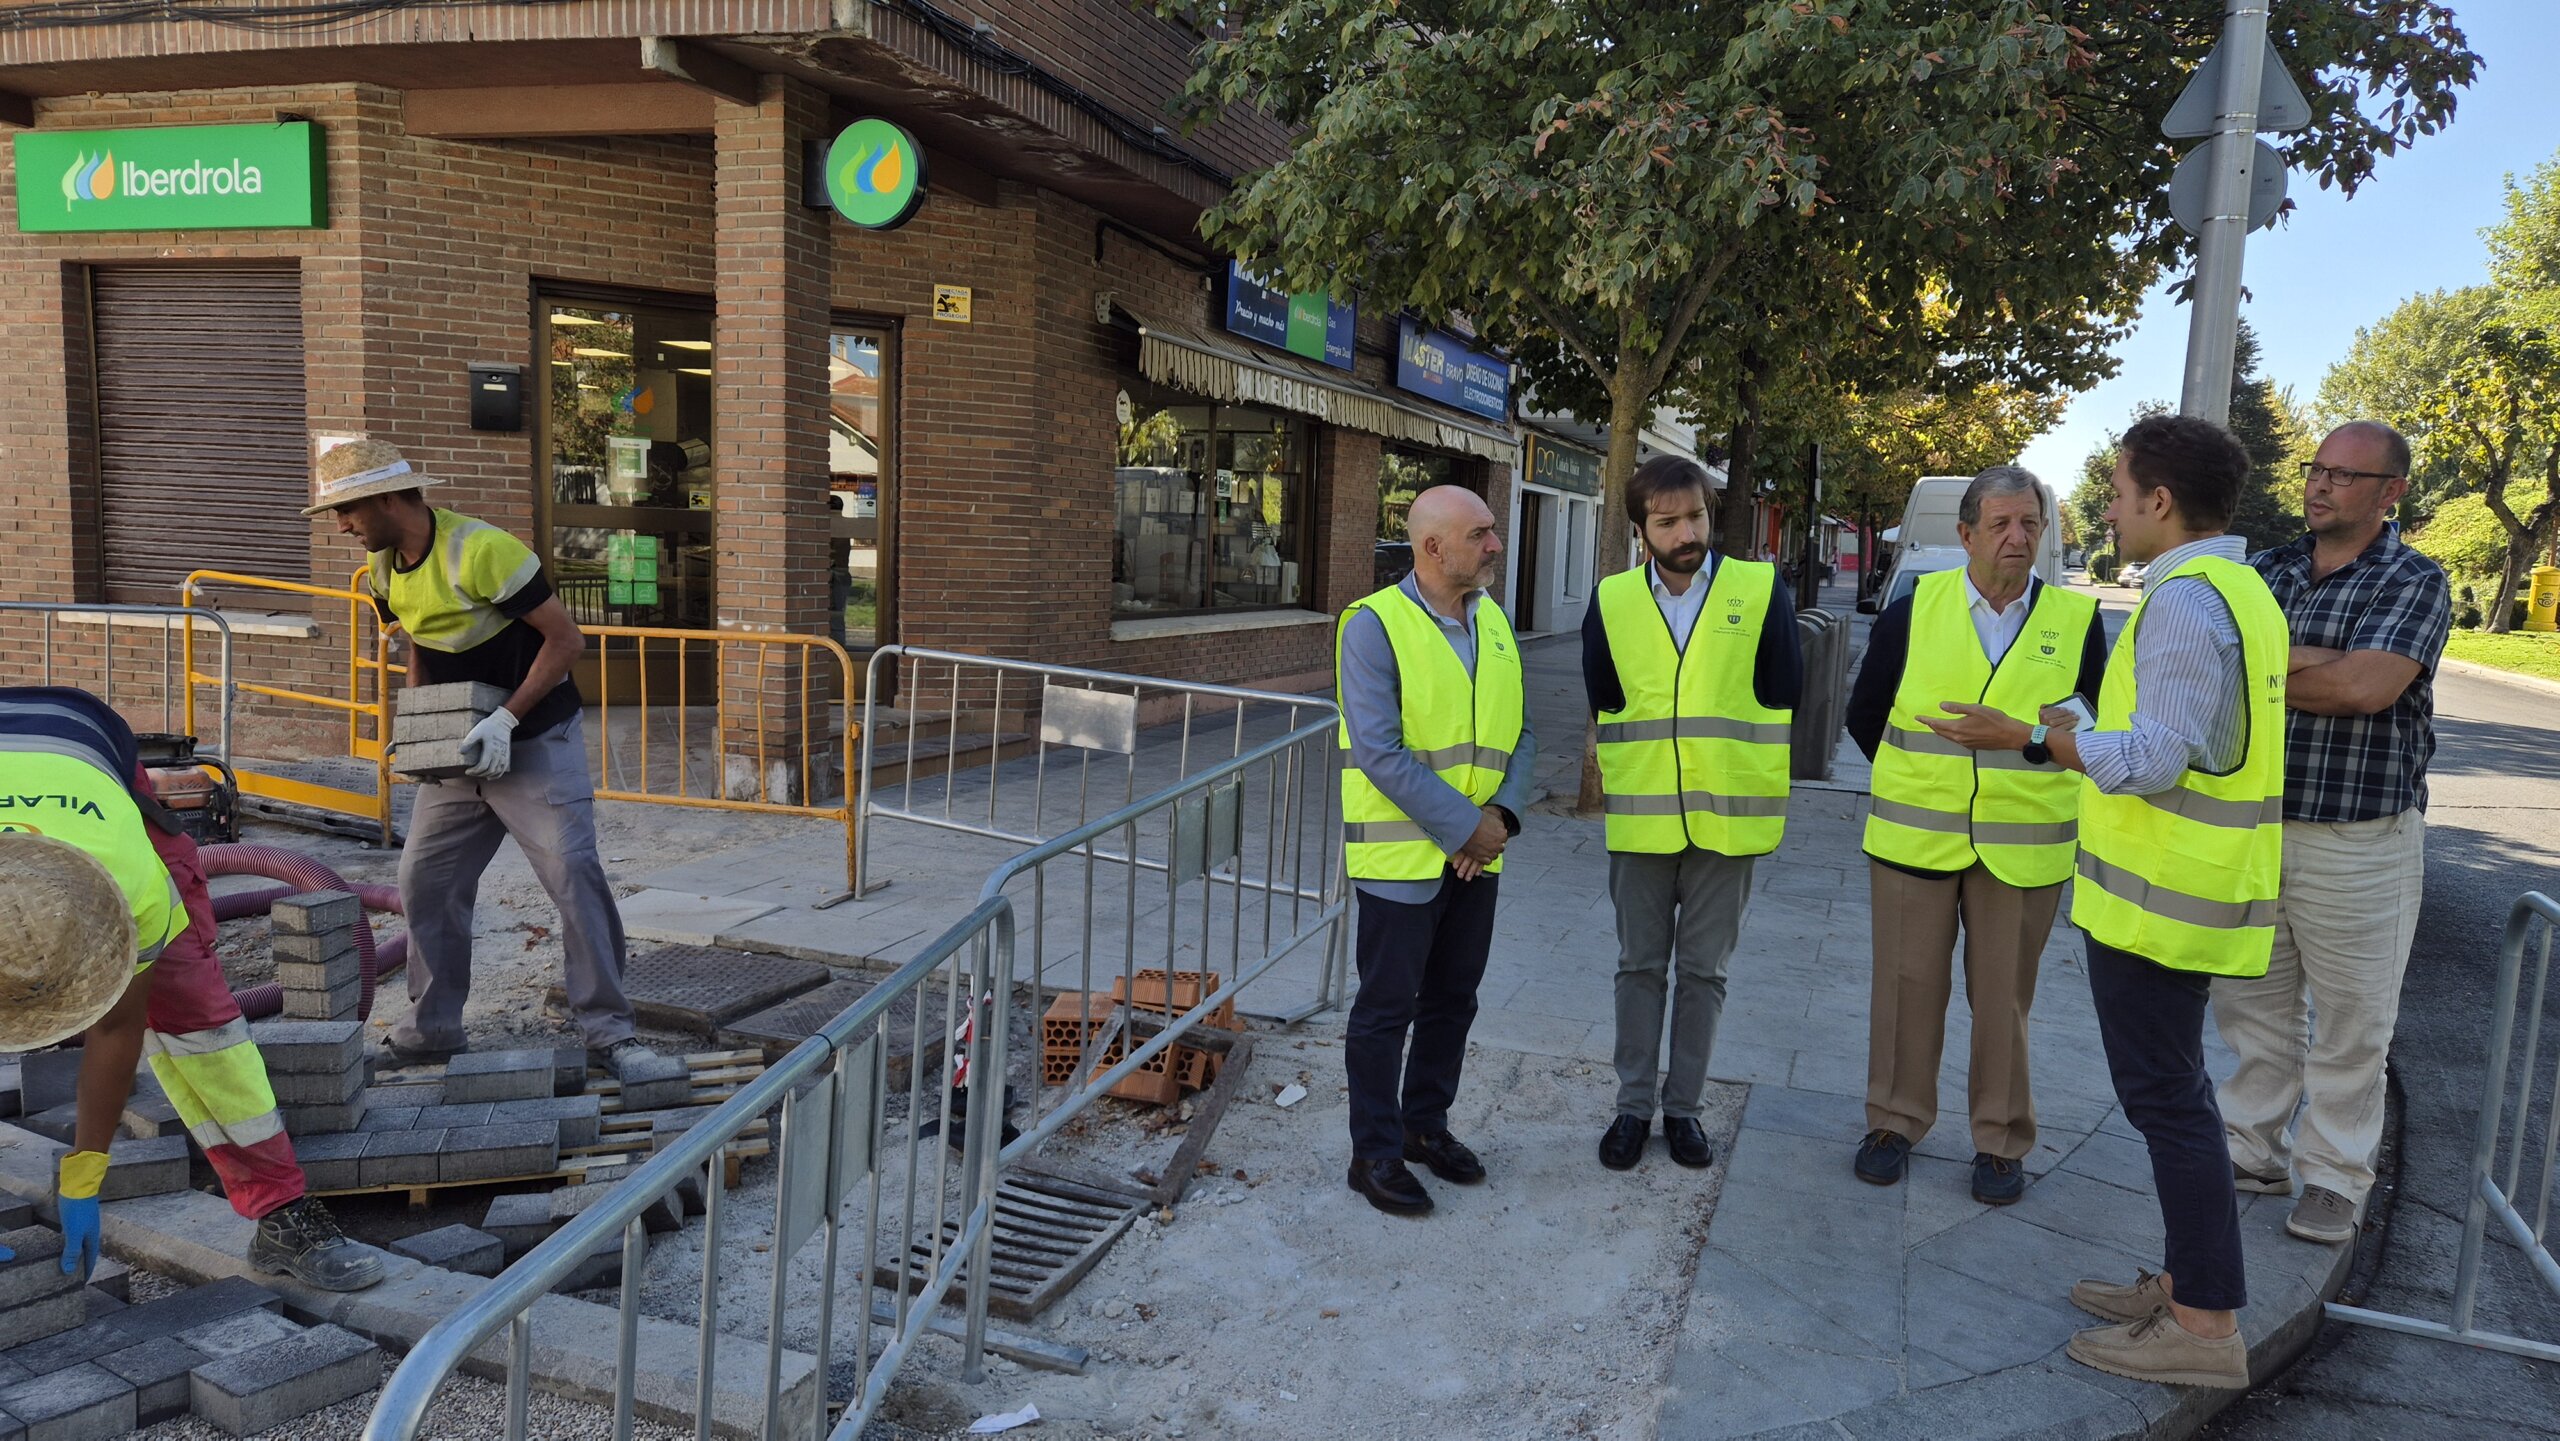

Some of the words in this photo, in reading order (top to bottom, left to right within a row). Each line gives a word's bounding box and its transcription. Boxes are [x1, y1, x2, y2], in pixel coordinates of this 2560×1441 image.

[122, 158, 262, 197] Iberdrola
[1235, 300, 1253, 320] Precio
[1253, 312, 1257, 328] y
[1258, 310, 1274, 326] mucho
[1328, 316, 1336, 329] Gas
[1402, 335, 1445, 375] MASTER
[1446, 363, 1464, 383] BRAVO
[1238, 366, 1328, 419] MUEBLES
[1465, 362, 1481, 384] DISEÑO
[1481, 370, 1488, 387] DE
[1488, 372, 1504, 393] COCINAS
